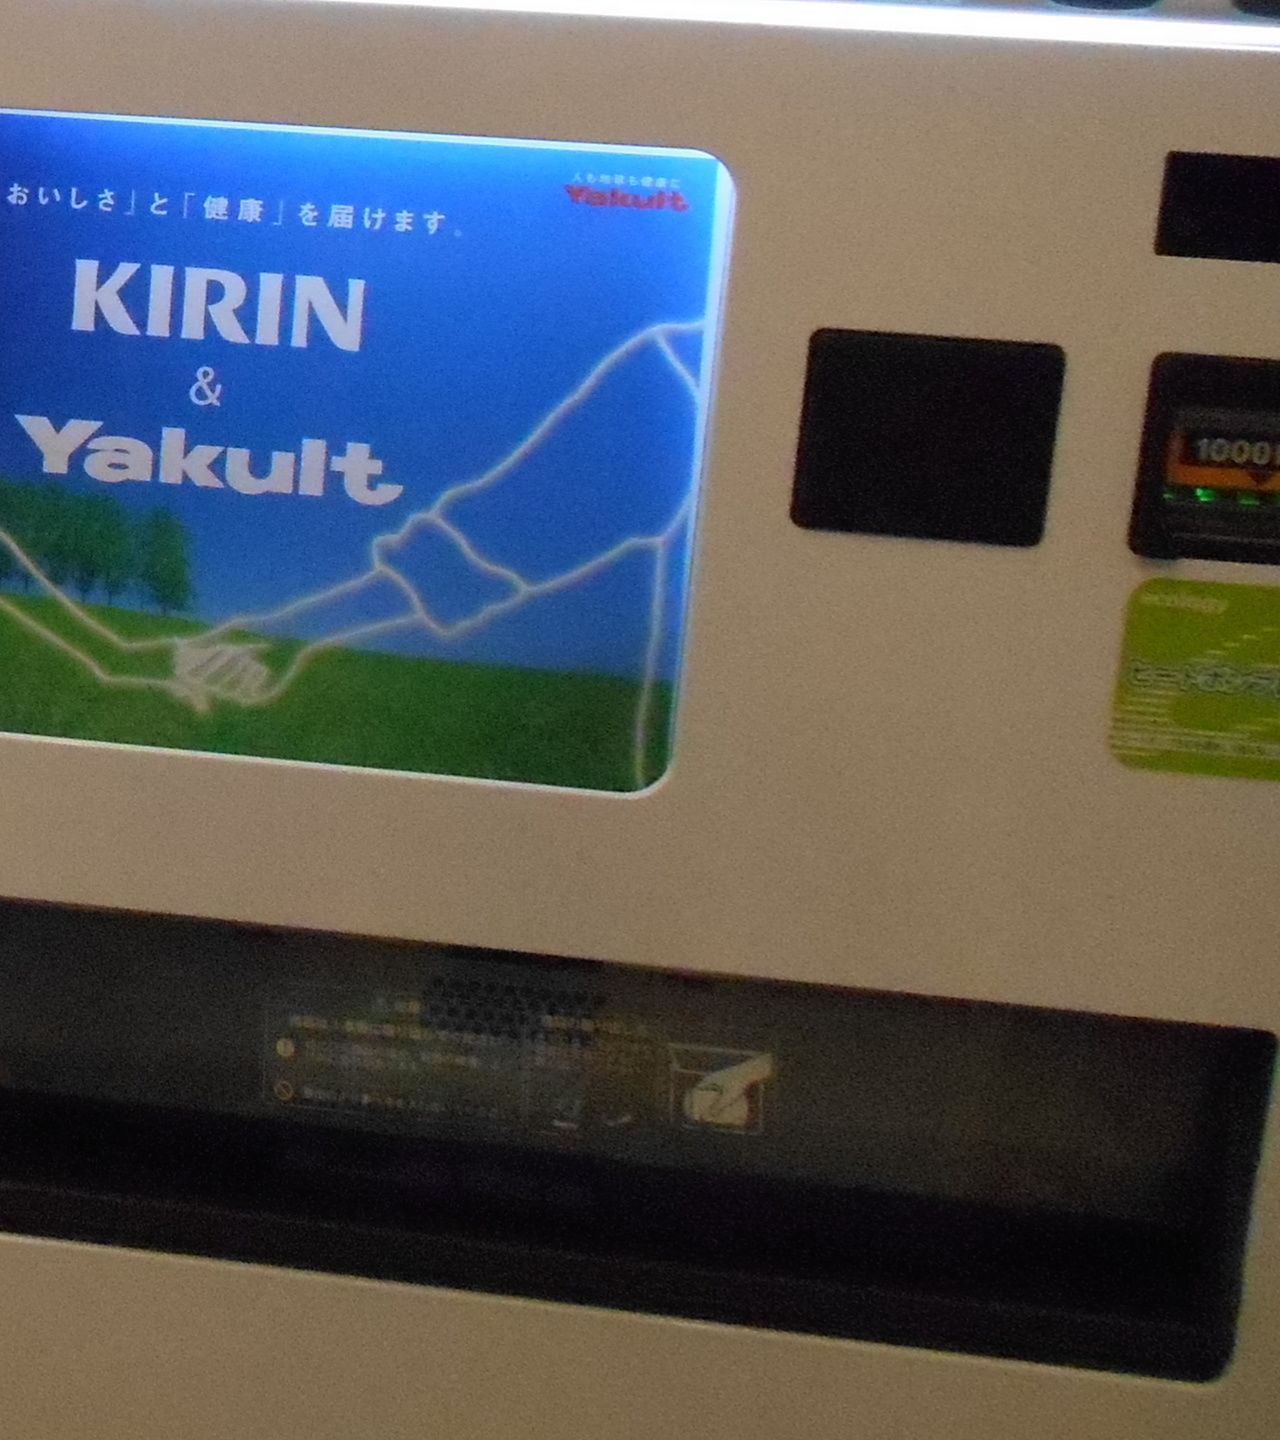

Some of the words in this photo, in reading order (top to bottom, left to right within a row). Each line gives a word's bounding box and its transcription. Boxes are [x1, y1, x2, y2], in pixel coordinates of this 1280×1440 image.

[71, 258, 367, 353] KIRIN
[189, 365, 223, 407] &
[14, 414, 404, 506] Yakult
[1197, 437, 1280, 466] 1000
